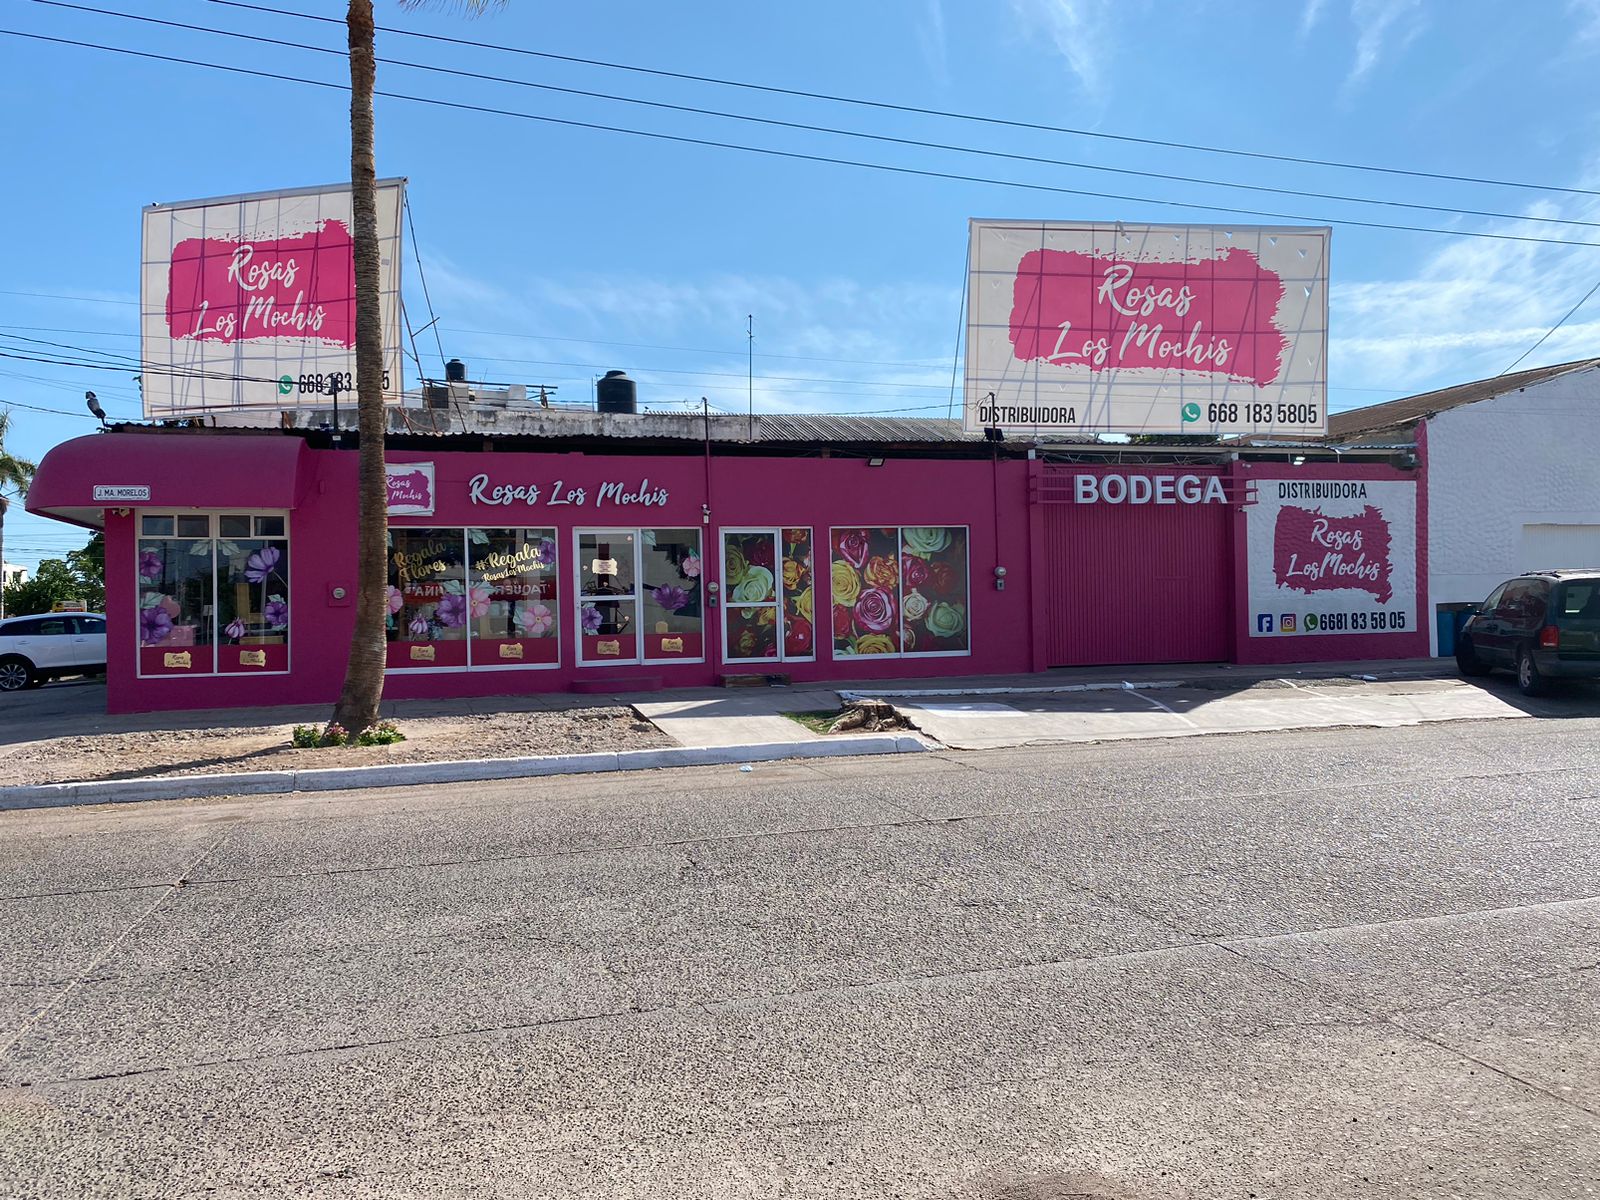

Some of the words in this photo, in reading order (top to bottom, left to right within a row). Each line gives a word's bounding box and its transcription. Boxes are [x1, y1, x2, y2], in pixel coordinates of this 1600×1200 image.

[228, 245, 299, 291] Rosas
[1097, 264, 1197, 317] Rosas
[192, 300, 238, 337] Los
[242, 290, 326, 332] Mochis
[1048, 321, 1112, 365] Los
[1119, 321, 1233, 366] Mochis
[980, 406, 1076, 424] DISTRIBUIDORA
[1208, 403, 1238, 423] 668
[1245, 403, 1273, 424] 183
[1277, 404, 1317, 424] 5805
[117, 489, 147, 497] MORELOS
[386, 475, 411, 488] Rosas
[469, 473, 541, 506] Rosas
[547, 480, 587, 506] Los
[596, 478, 669, 508] Mochis
[1074, 474, 1228, 504] BODEGA
[1278, 482, 1368, 500] DISTRIBUIDORA
[1311, 518, 1363, 551] Rosas
[393, 539, 447, 568] Regala
[475, 543, 542, 571] #Regala
[1318, 553, 1381, 581] Mochis
[399, 559, 447, 581] Flores
[1320, 613, 1348, 631] 6681
[1351, 612, 1367, 630] 83
[1371, 612, 1387, 630] 58
[1390, 611, 1406, 629] 05
